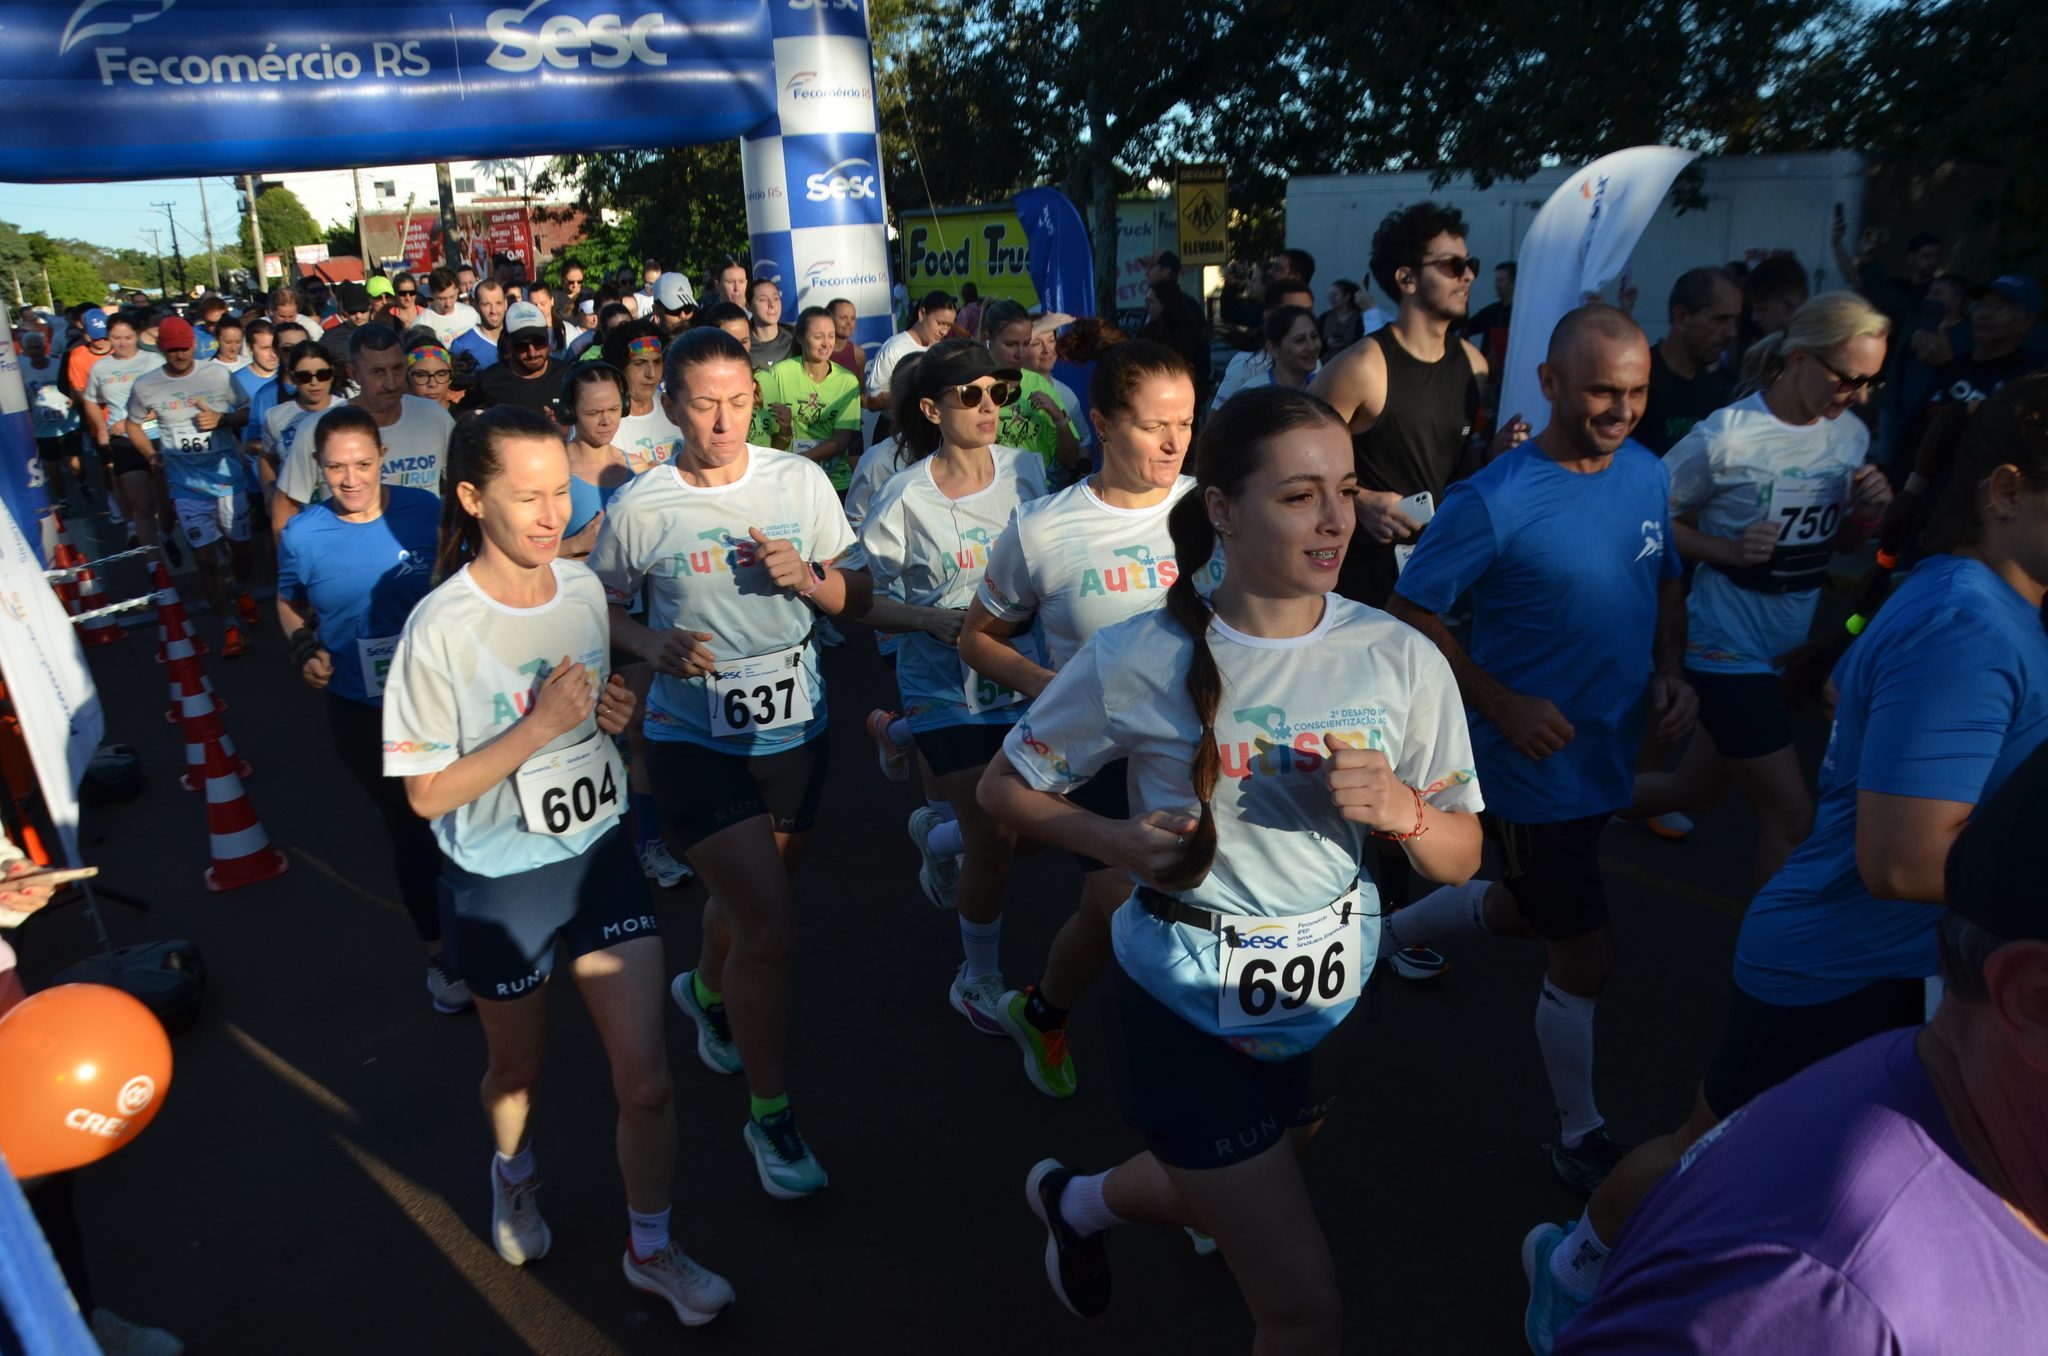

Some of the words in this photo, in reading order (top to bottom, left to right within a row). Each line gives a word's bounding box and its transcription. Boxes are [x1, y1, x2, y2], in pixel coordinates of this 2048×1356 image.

[486, 8, 668, 73] Sesc
[96, 43, 361, 86] Fecomércio
[373, 41, 431, 78] RS
[793, 86, 860, 99] Fecomércio
[768, 186, 783, 199] RS
[806, 173, 875, 201] Sesc
[909, 227, 971, 278] Food
[1183, 240, 1225, 255] ELEVADA
[811, 271, 877, 288] Fecomércio
[180, 436, 212, 453] 861
[381, 454, 436, 475] AMZOP
[409, 470, 437, 485] RUN
[1777, 503, 1840, 542] 750
[724, 677, 795, 729] 637
[1341, 707, 1377, 718] DESAFIO
[1294, 715, 1376, 731] CONSCIENTIZAÇÃO
[542, 761, 618, 834] 604
[712, 796, 760, 823] RUN
[496, 969, 540, 997] RUN
[602, 914, 658, 941] MORE
[1238, 941, 1346, 1017] 696
[1214, 1113, 1279, 1158] RUN
